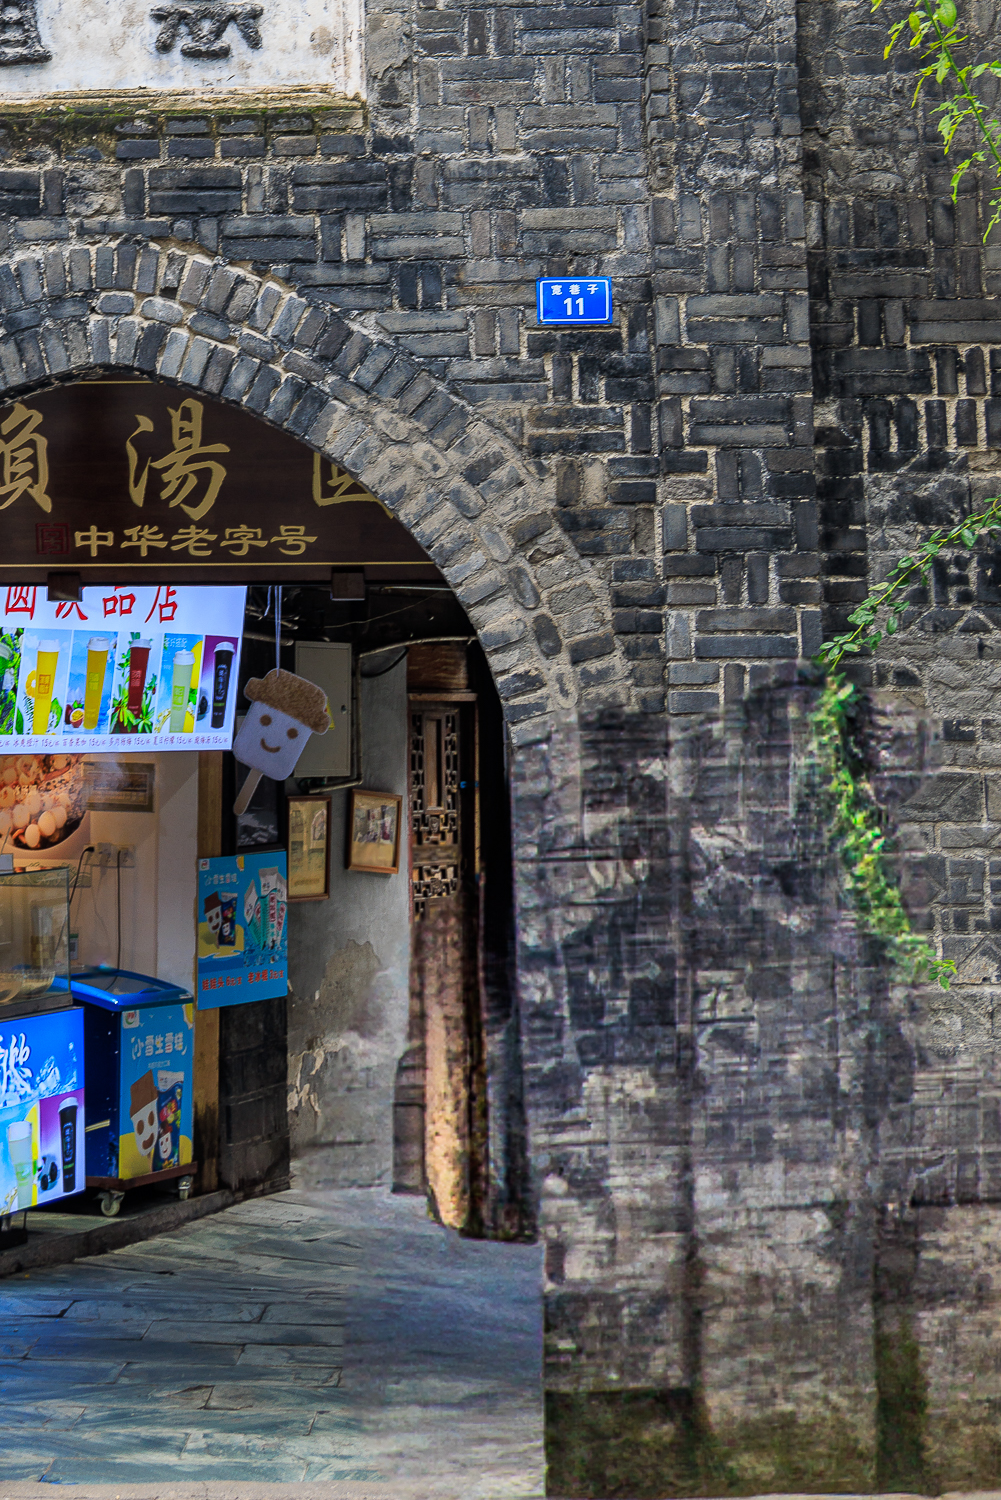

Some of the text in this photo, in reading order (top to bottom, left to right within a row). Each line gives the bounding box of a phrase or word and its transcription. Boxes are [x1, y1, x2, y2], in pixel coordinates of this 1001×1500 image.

[551, 284, 598, 295] 宽巷子
[564, 298, 584, 315] 11
[74, 525, 318, 557] 中华老字号
